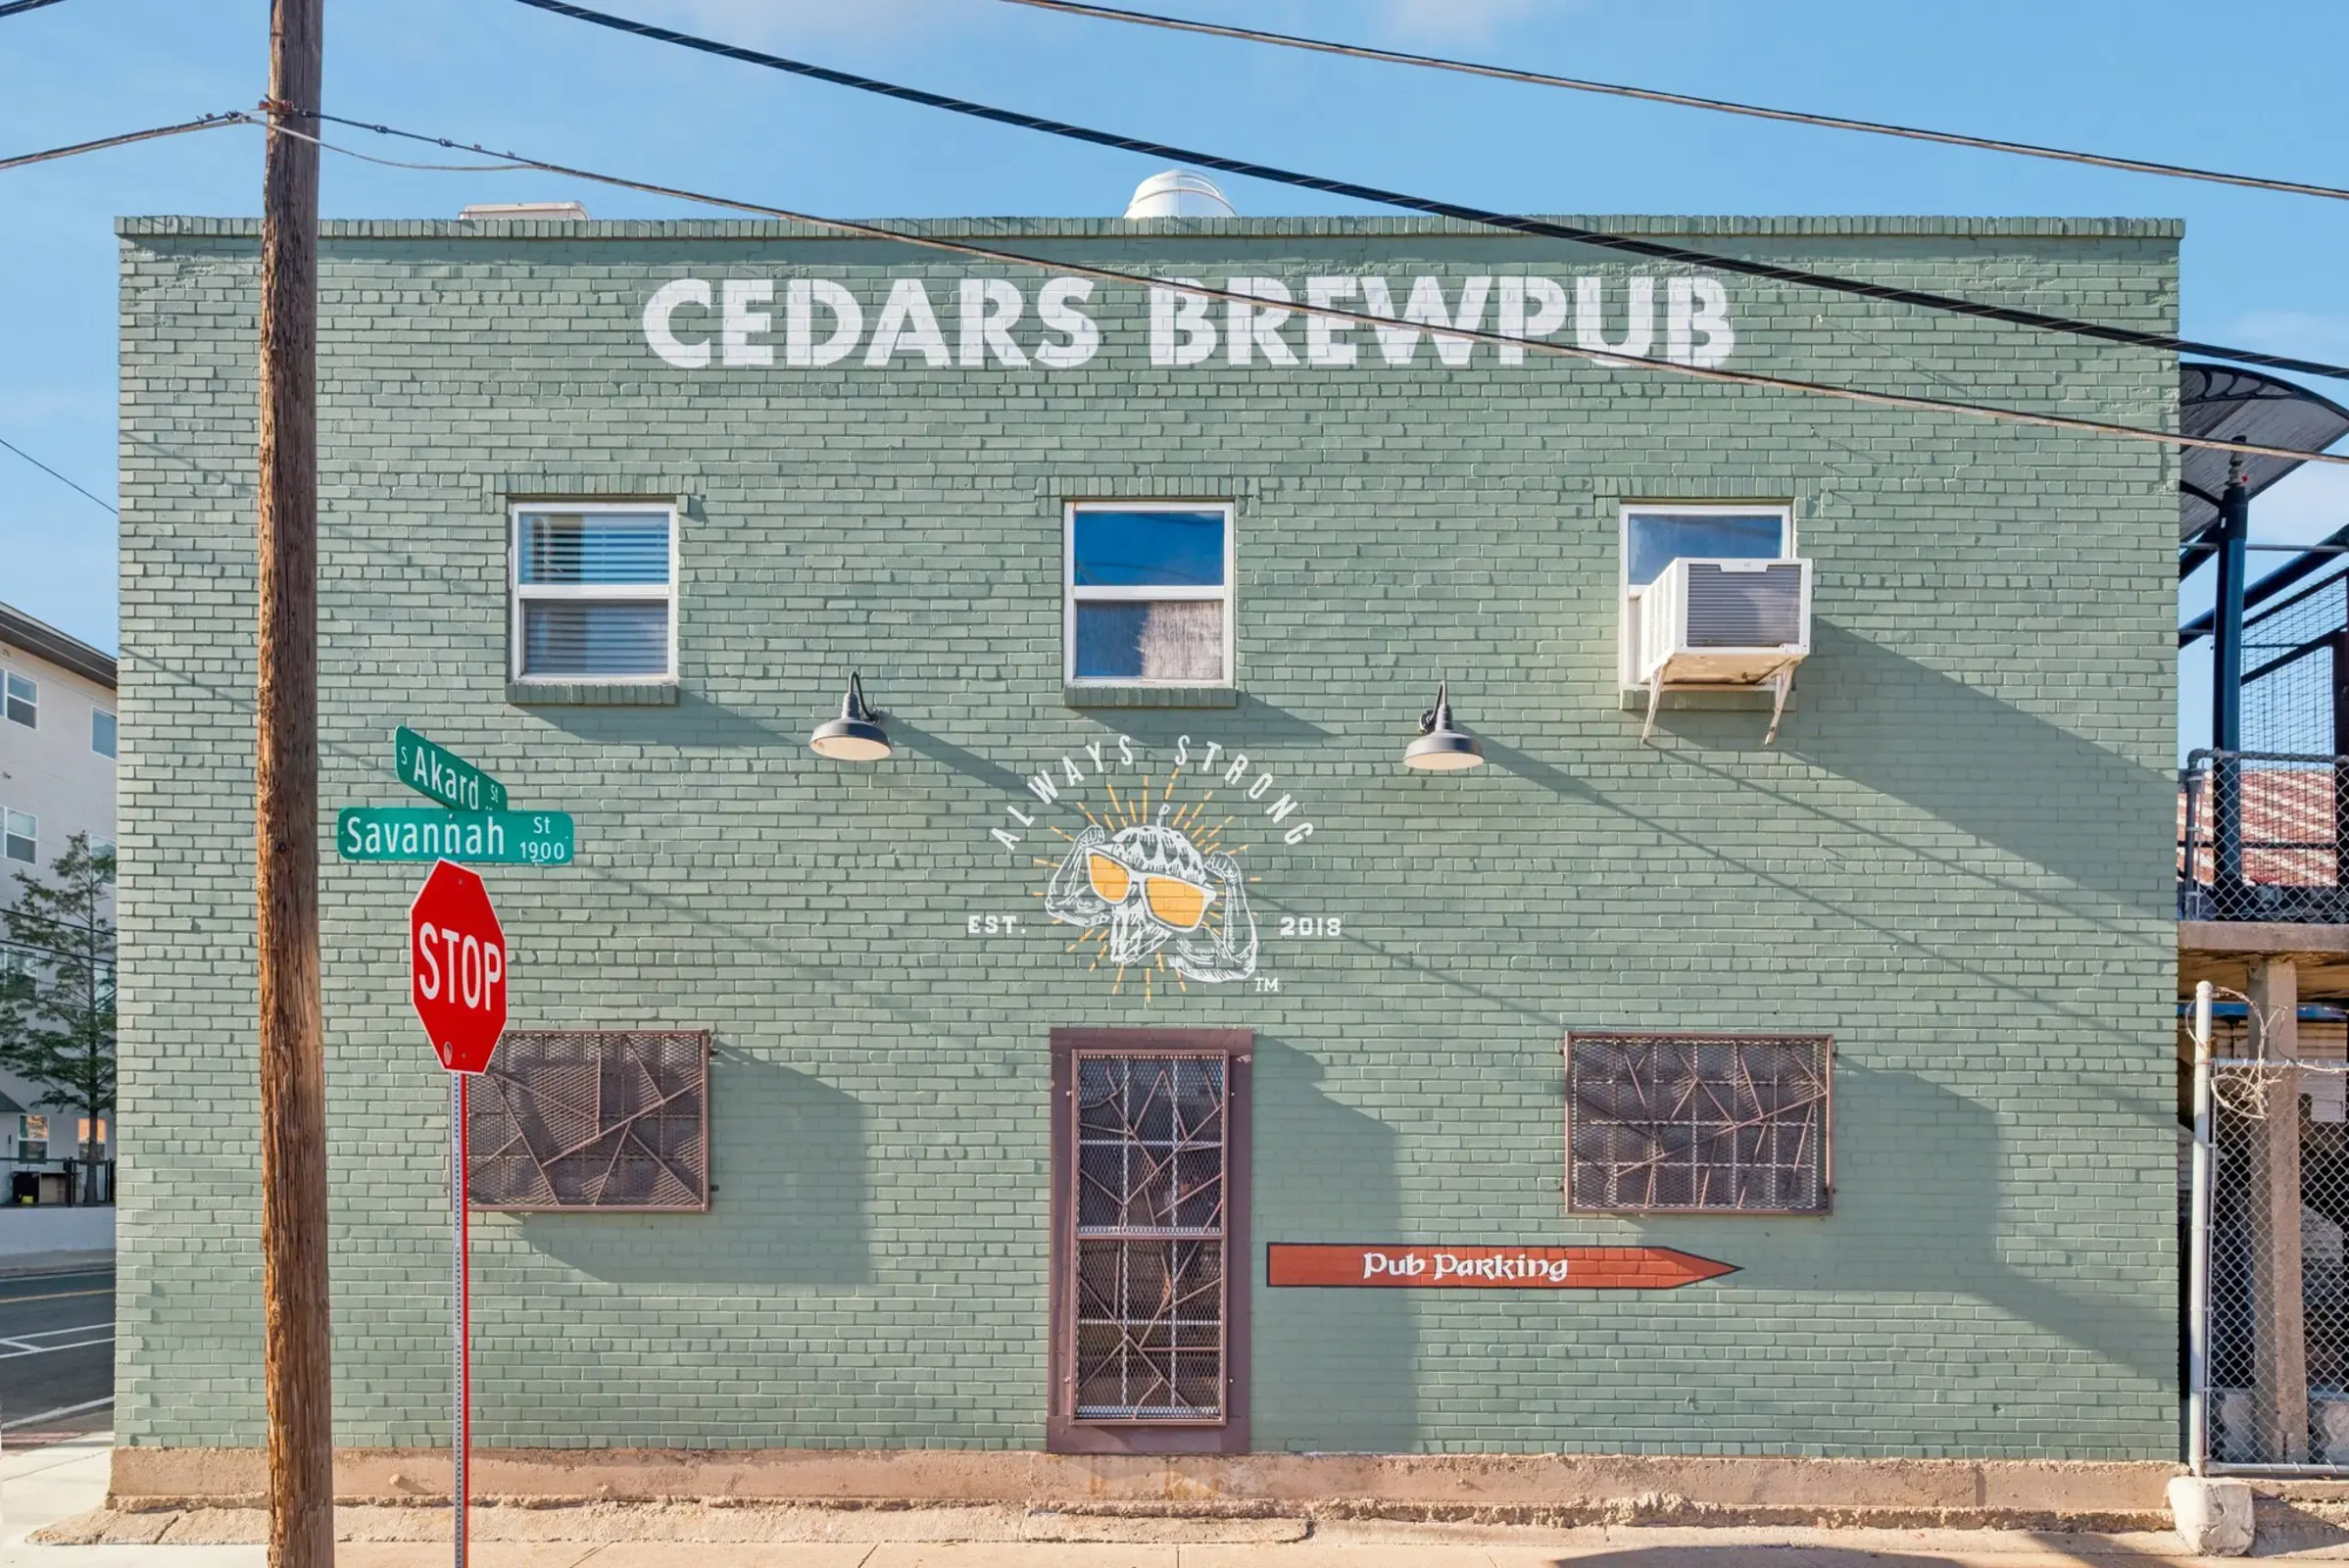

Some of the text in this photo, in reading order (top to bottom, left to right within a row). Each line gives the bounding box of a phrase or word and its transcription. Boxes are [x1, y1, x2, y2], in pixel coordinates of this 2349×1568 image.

[642, 276, 1736, 368] CEDARS BREWPUB
[401, 746, 499, 810] S Akard St
[991, 734, 1314, 851] ALWAYS STRONG
[347, 815, 551, 856] Savannah St
[519, 841, 564, 860] 1900
[967, 914, 1028, 935] EST.
[1280, 916, 1342, 936] 2018
[418, 921, 502, 1011] STOP
[1254, 977, 1279, 993] TM
[1362, 1251, 1569, 1281] Pub Parking
